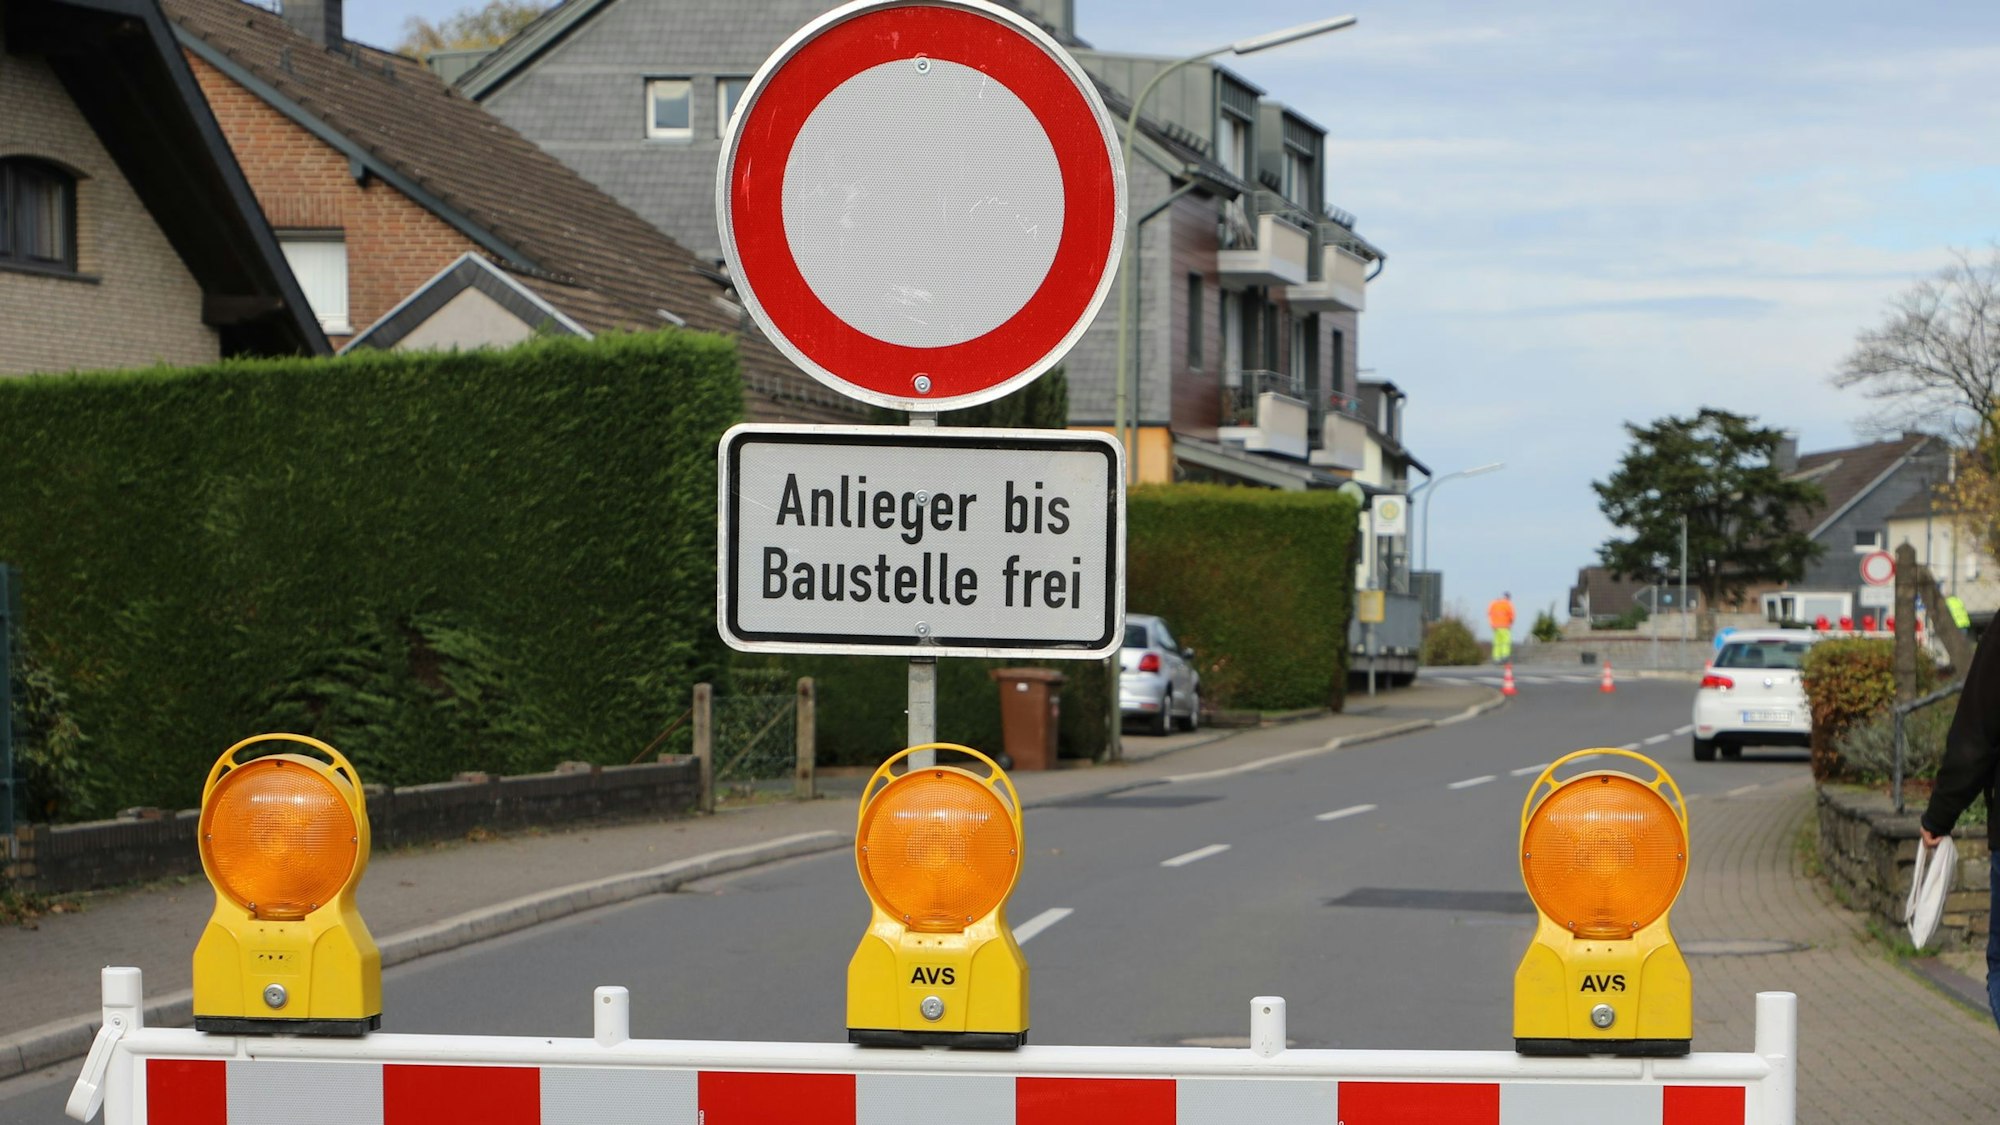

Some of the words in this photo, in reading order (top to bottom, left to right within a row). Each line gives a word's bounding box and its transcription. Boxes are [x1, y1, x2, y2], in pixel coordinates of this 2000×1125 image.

[776, 473, 977, 545] Anlieger
[1005, 480, 1070, 535] bis
[762, 546, 978, 606] Baustelle
[1002, 555, 1081, 609] frei
[910, 966, 956, 985] AVS
[1580, 974, 1626, 992] AVS
